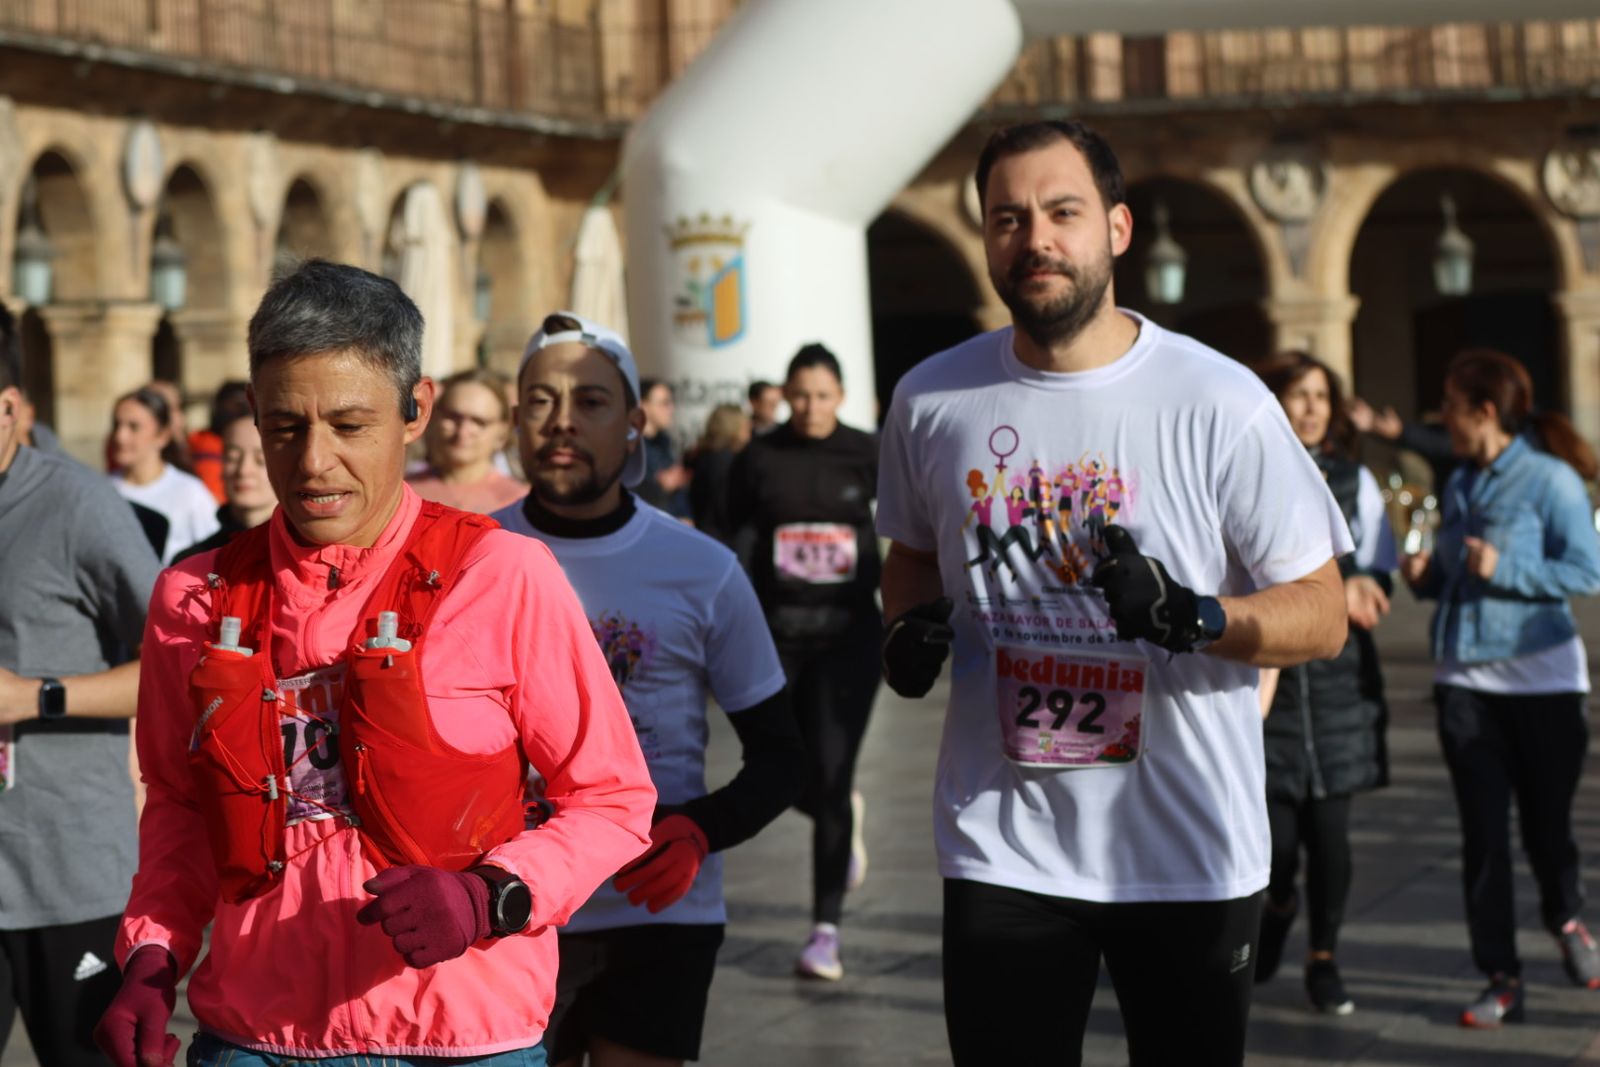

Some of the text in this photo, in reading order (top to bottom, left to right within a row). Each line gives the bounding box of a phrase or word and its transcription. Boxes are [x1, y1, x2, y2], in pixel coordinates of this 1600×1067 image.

[1056, 617, 1073, 628] DE
[1079, 617, 1117, 629] SALA
[1088, 632, 1104, 644] de
[996, 648, 1143, 693] bedunia
[1015, 686, 1107, 734] 292
[281, 718, 339, 777] 70
